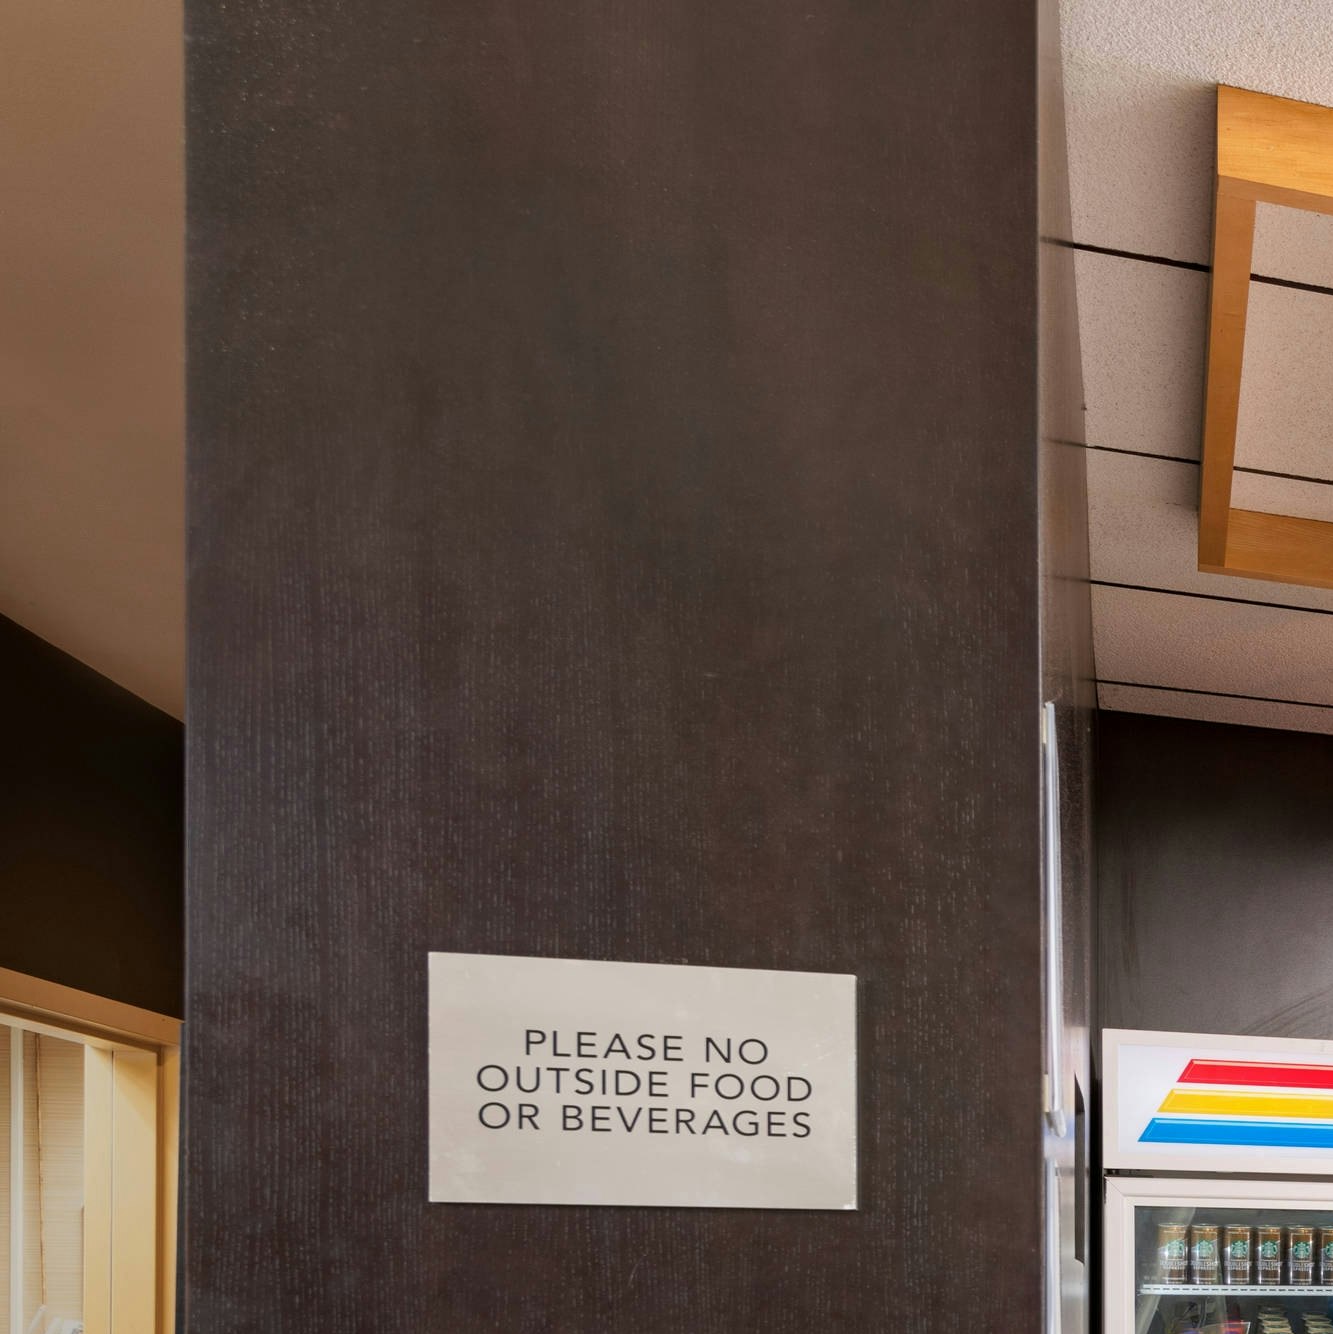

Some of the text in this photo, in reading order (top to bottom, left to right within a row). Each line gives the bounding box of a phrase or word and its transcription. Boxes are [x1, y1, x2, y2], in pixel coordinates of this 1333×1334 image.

[525, 1029, 769, 1065] PLEASE NO
[477, 1065, 812, 1102] OUTSIDE FOOD
[478, 1102, 811, 1138] OR BEVERAGES
